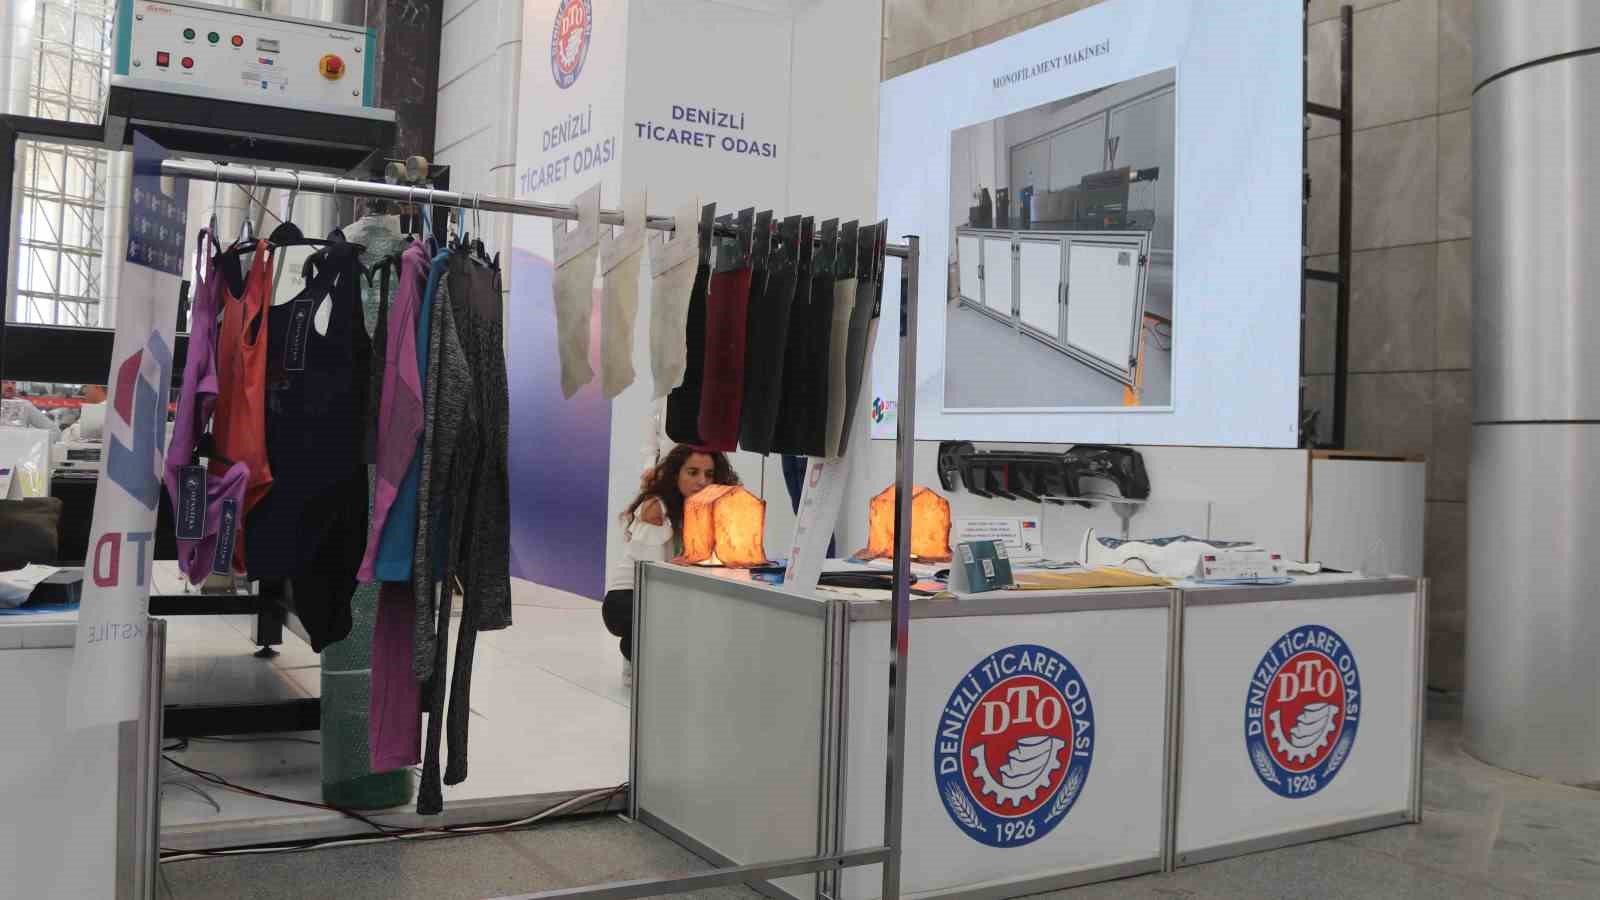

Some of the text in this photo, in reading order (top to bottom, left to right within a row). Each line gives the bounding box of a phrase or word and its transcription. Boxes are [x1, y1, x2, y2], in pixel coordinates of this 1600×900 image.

[992, 38, 1110, 89] MONOFİLAMENT MAKİNESİ
[542, 104, 592, 152] DENİZLİ
[635, 122, 777, 158] TİCARET ODASI
[672, 105, 745, 130] DENİZLİ
[521, 136, 615, 195] TİCARET ODASI
[1248, 630, 1359, 736] DENİZLİ TİCARET ODASI
[1277, 659, 1338, 702] DTO
[940, 650, 1091, 774] DENİZLİ TİCARET ODASI
[980, 685, 1062, 736] DTO
[1287, 774, 1317, 794] 1926
[996, 819, 1036, 843] 1926
